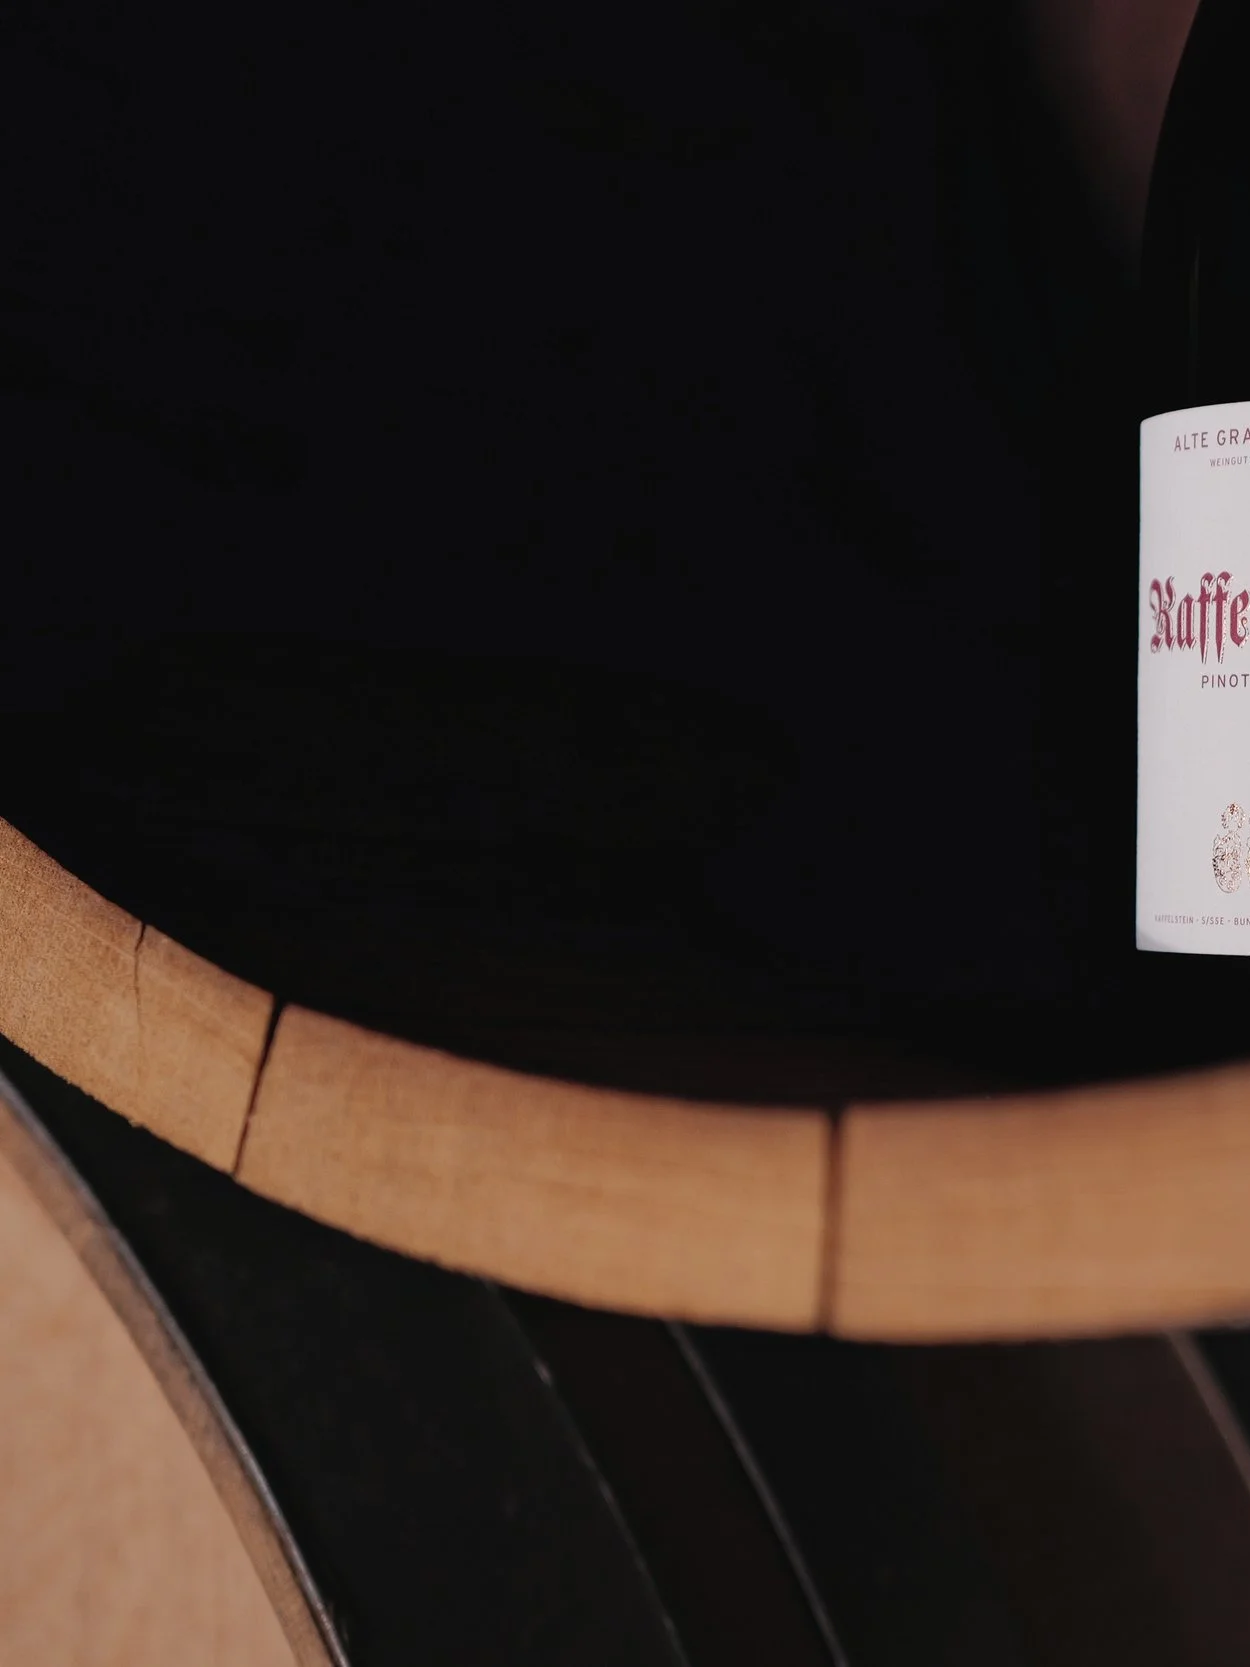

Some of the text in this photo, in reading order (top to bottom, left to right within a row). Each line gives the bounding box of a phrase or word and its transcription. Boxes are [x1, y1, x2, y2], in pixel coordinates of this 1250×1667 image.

[1174, 431, 1209, 452] ALTE
[1209, 456, 1248, 467] WEINGUT
[1201, 674, 1250, 689] PINOT
